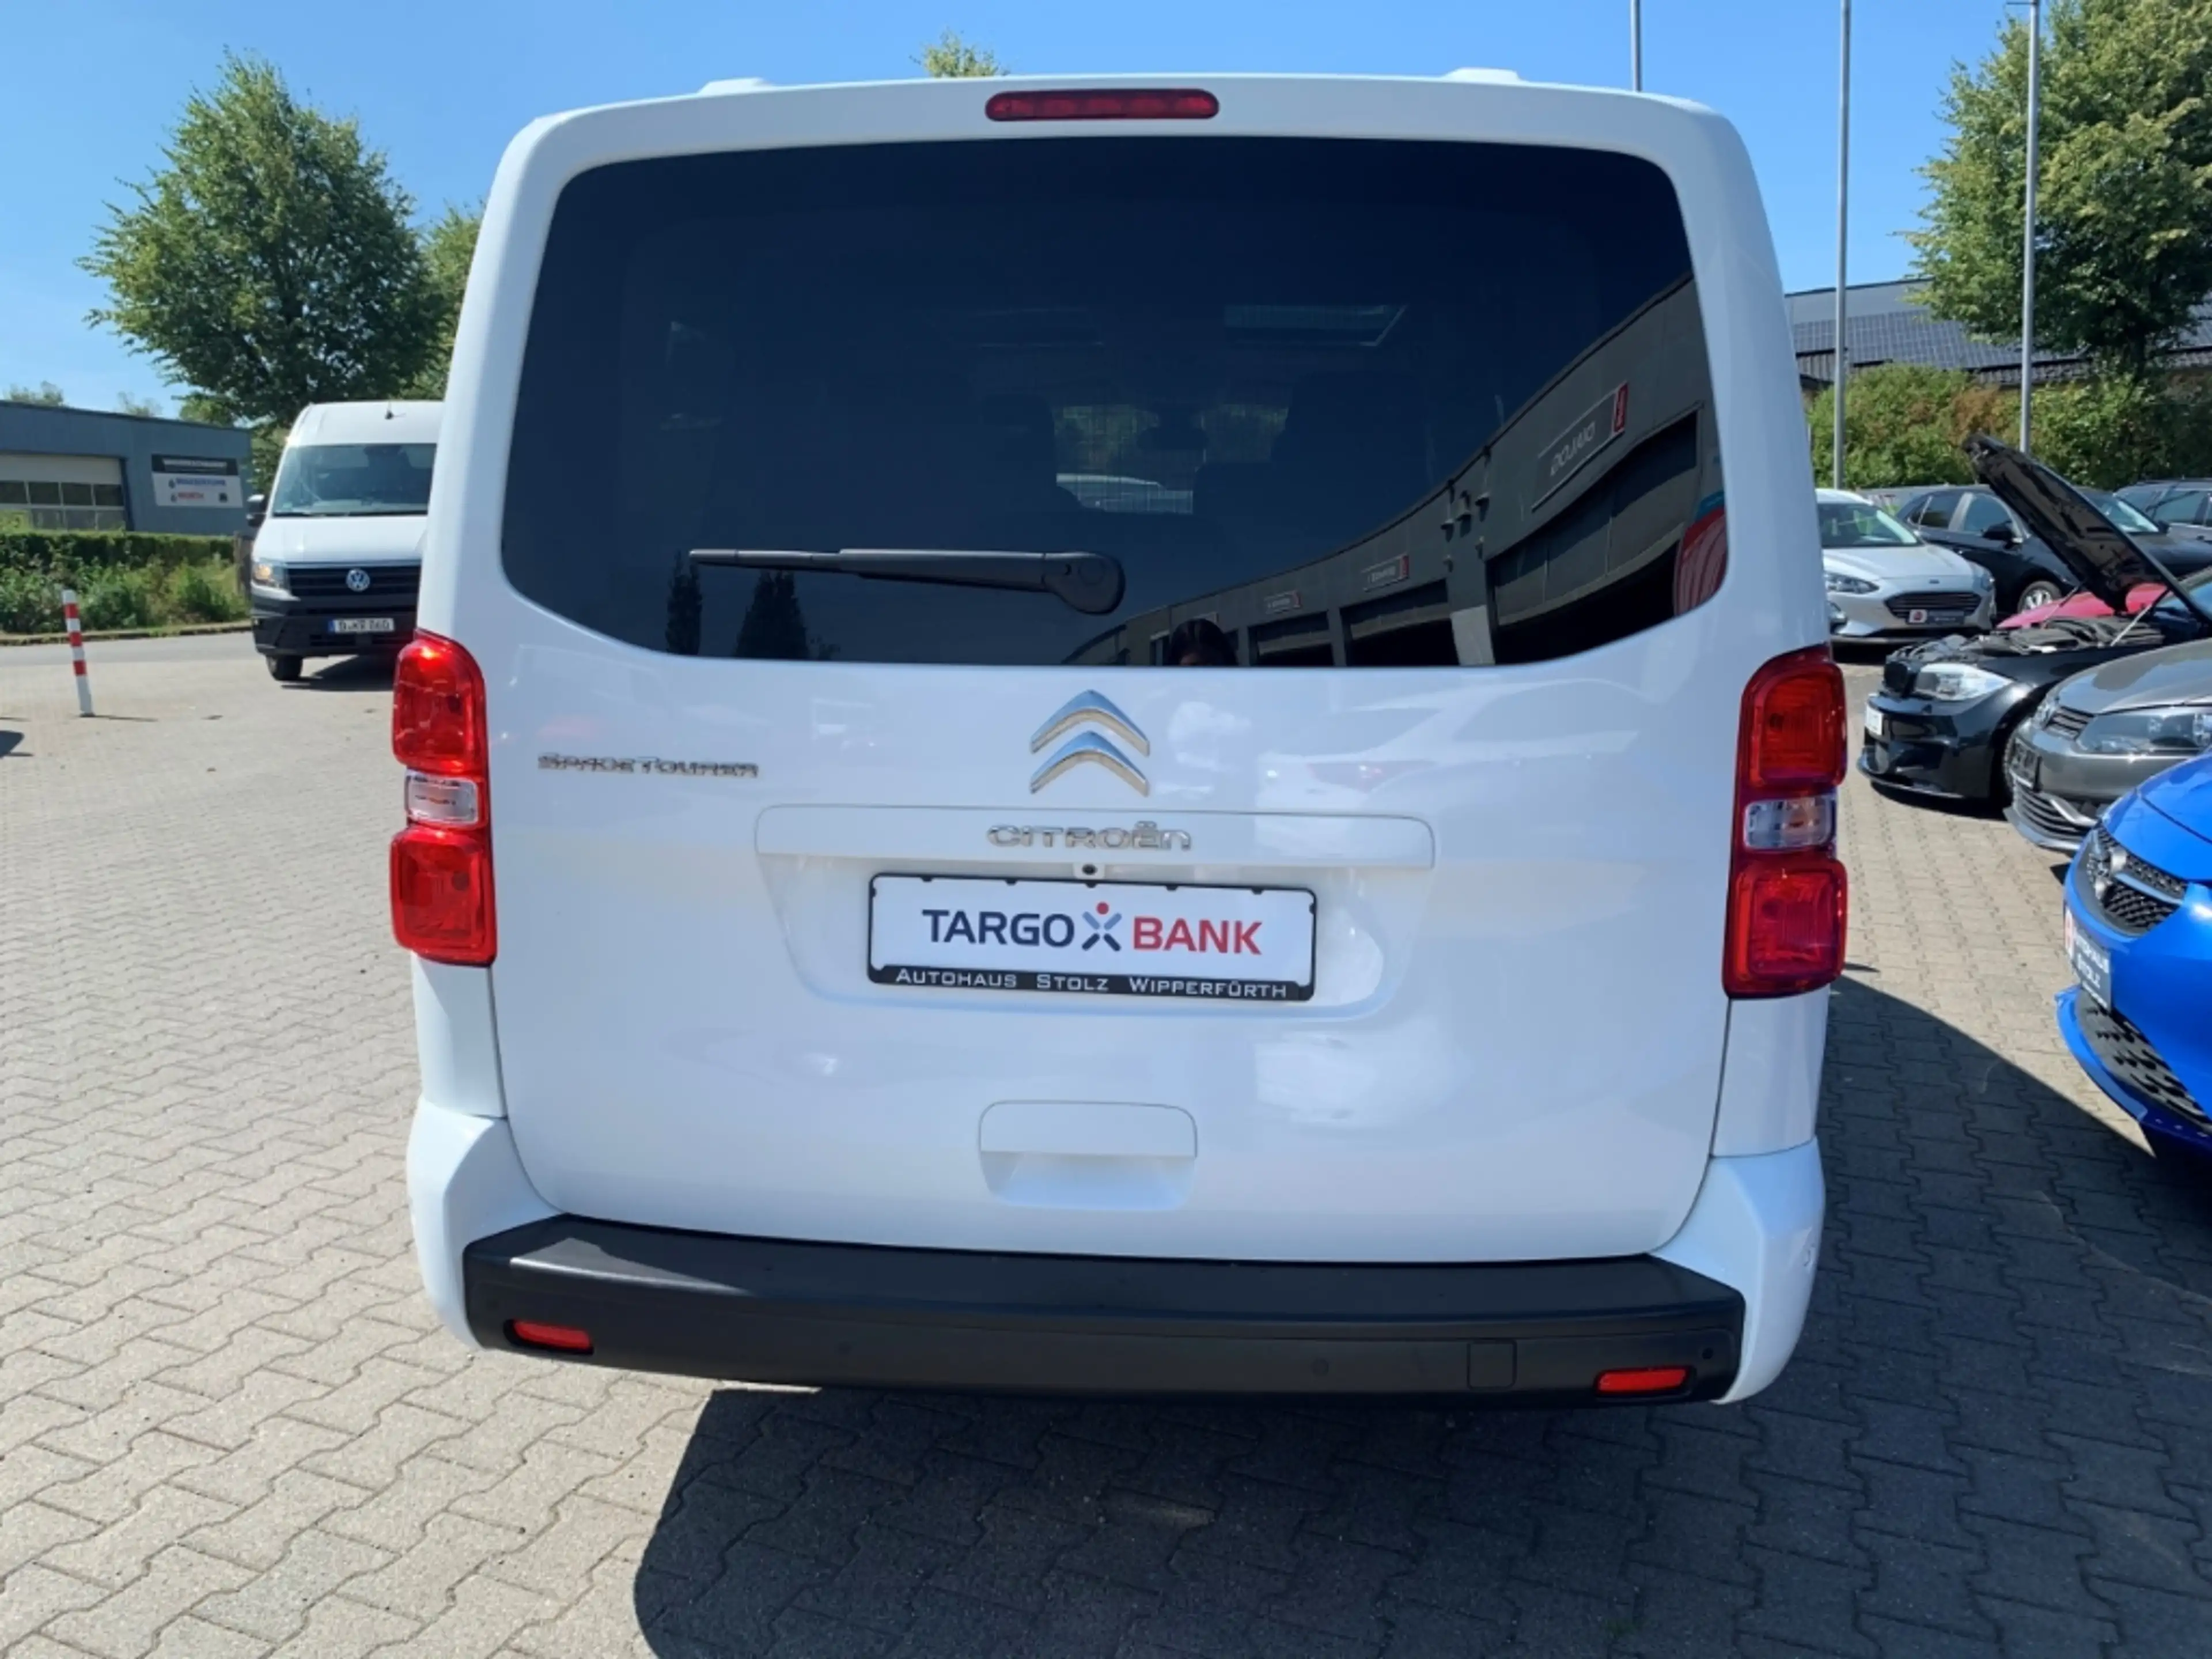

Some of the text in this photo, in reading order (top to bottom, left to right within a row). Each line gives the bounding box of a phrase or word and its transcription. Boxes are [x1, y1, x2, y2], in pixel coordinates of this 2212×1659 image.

[922, 909, 1263, 955] TARGO BANK
[896, 968, 1286, 998] AUTOHAUS STOLZ WIPPERFÜRTH
